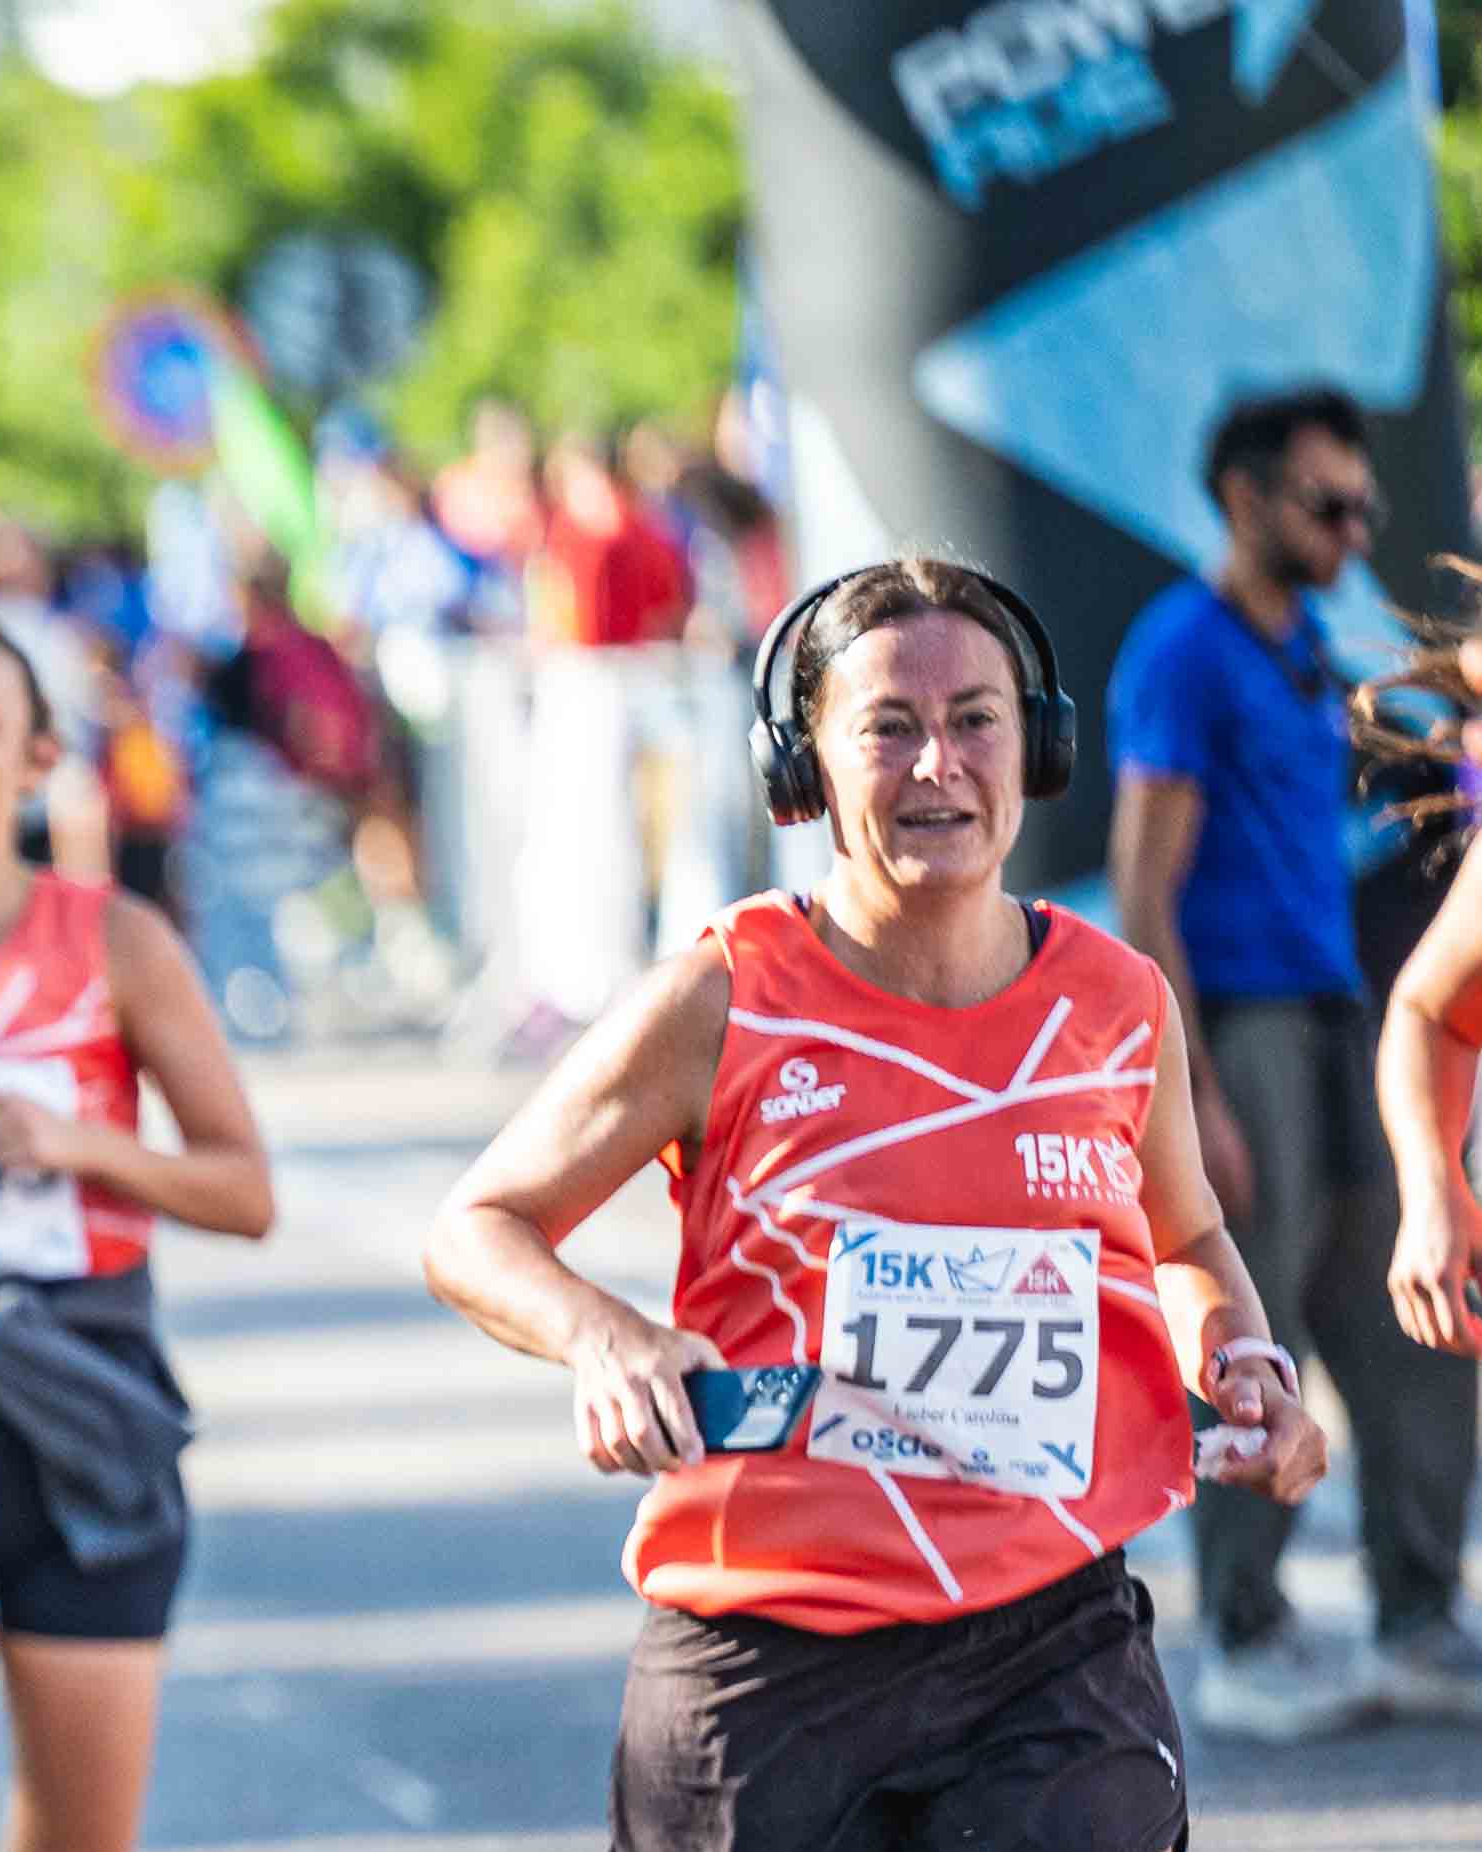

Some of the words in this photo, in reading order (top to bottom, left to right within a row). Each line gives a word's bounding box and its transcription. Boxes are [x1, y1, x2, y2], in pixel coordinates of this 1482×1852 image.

[1015, 1133, 1098, 1185] 15K
[860, 1250, 934, 1289] 15K
[837, 1312, 1084, 1400] 1775
